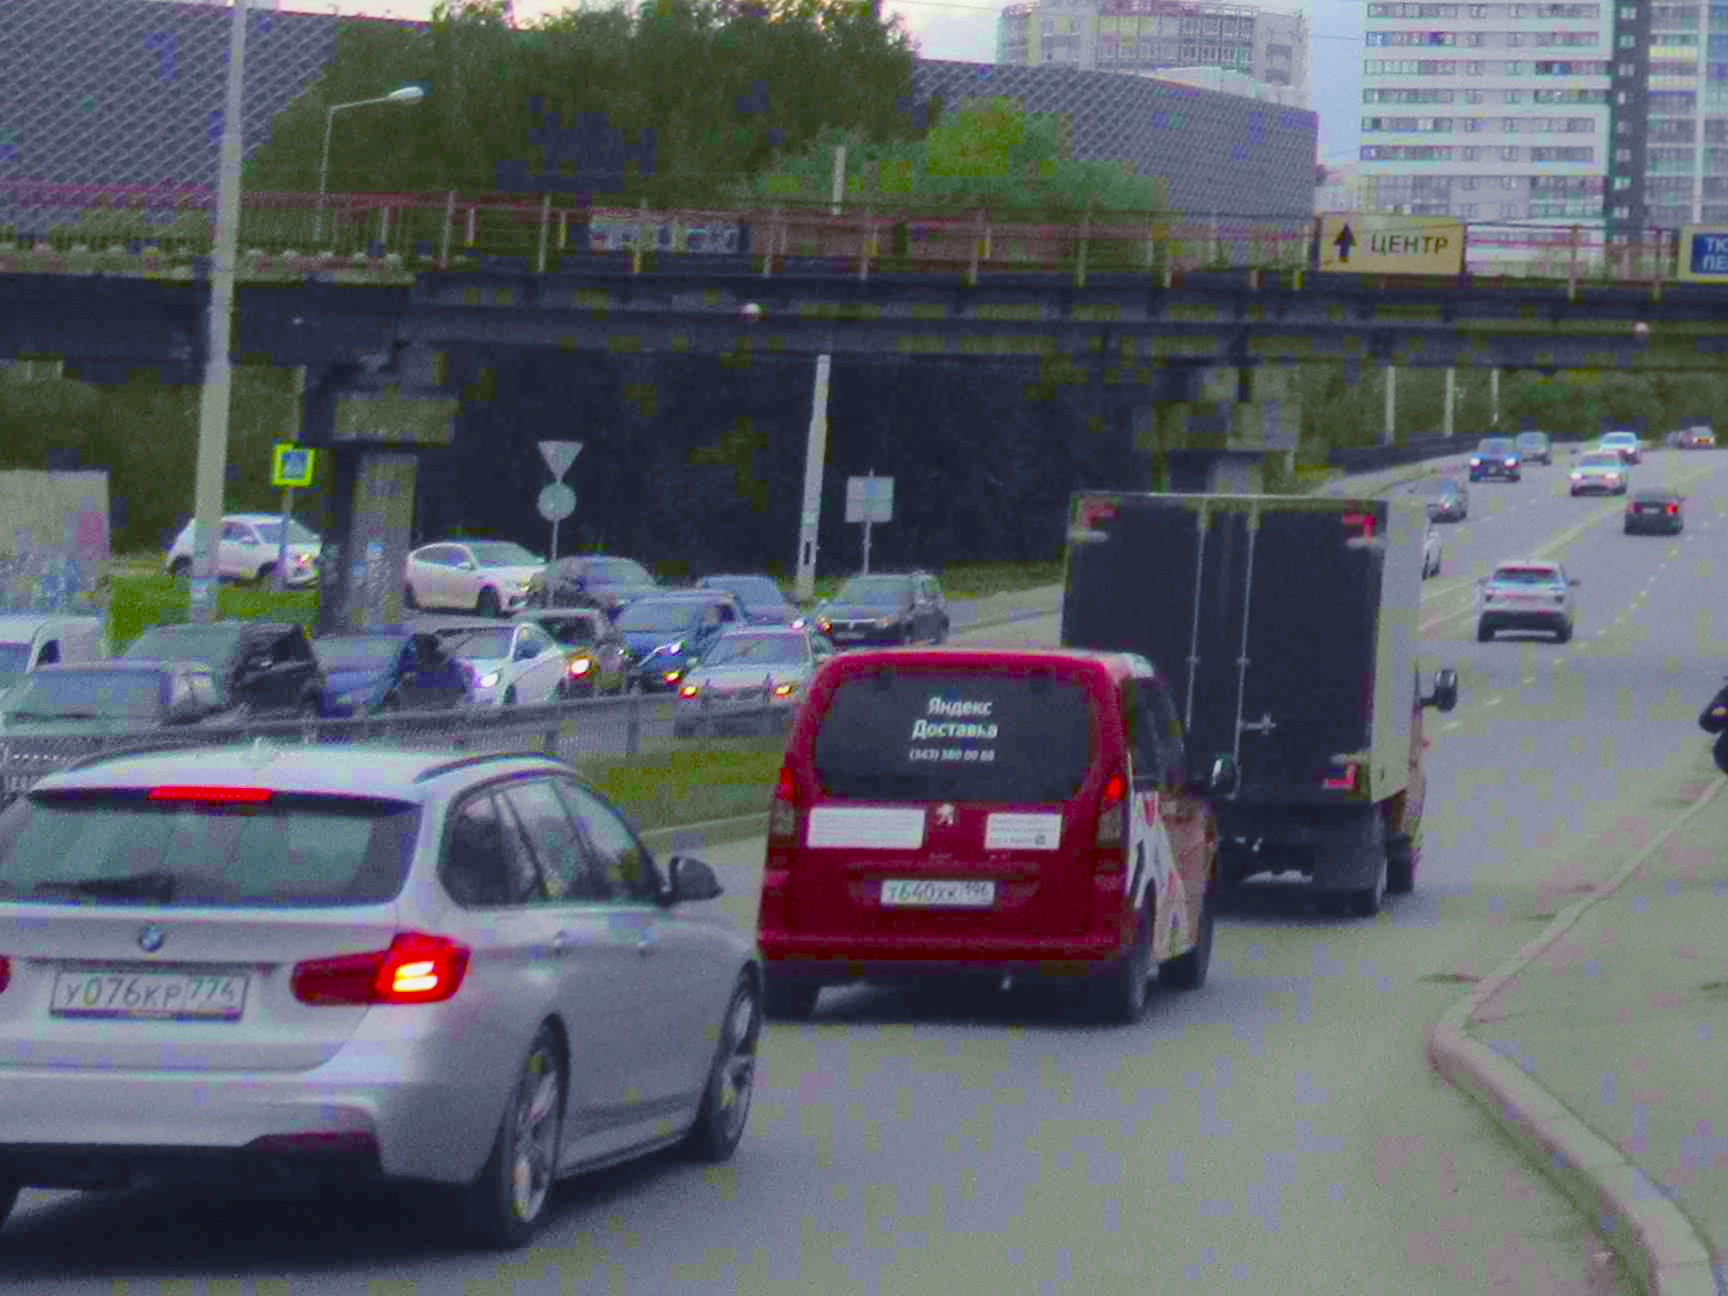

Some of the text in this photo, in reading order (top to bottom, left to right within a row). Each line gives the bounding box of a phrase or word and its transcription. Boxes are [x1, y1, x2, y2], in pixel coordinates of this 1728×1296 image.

[1370, 234, 1449, 256] ЦЕНТР
[928, 696, 993, 717] Яндекс
[911, 719, 998, 740] Доставка
